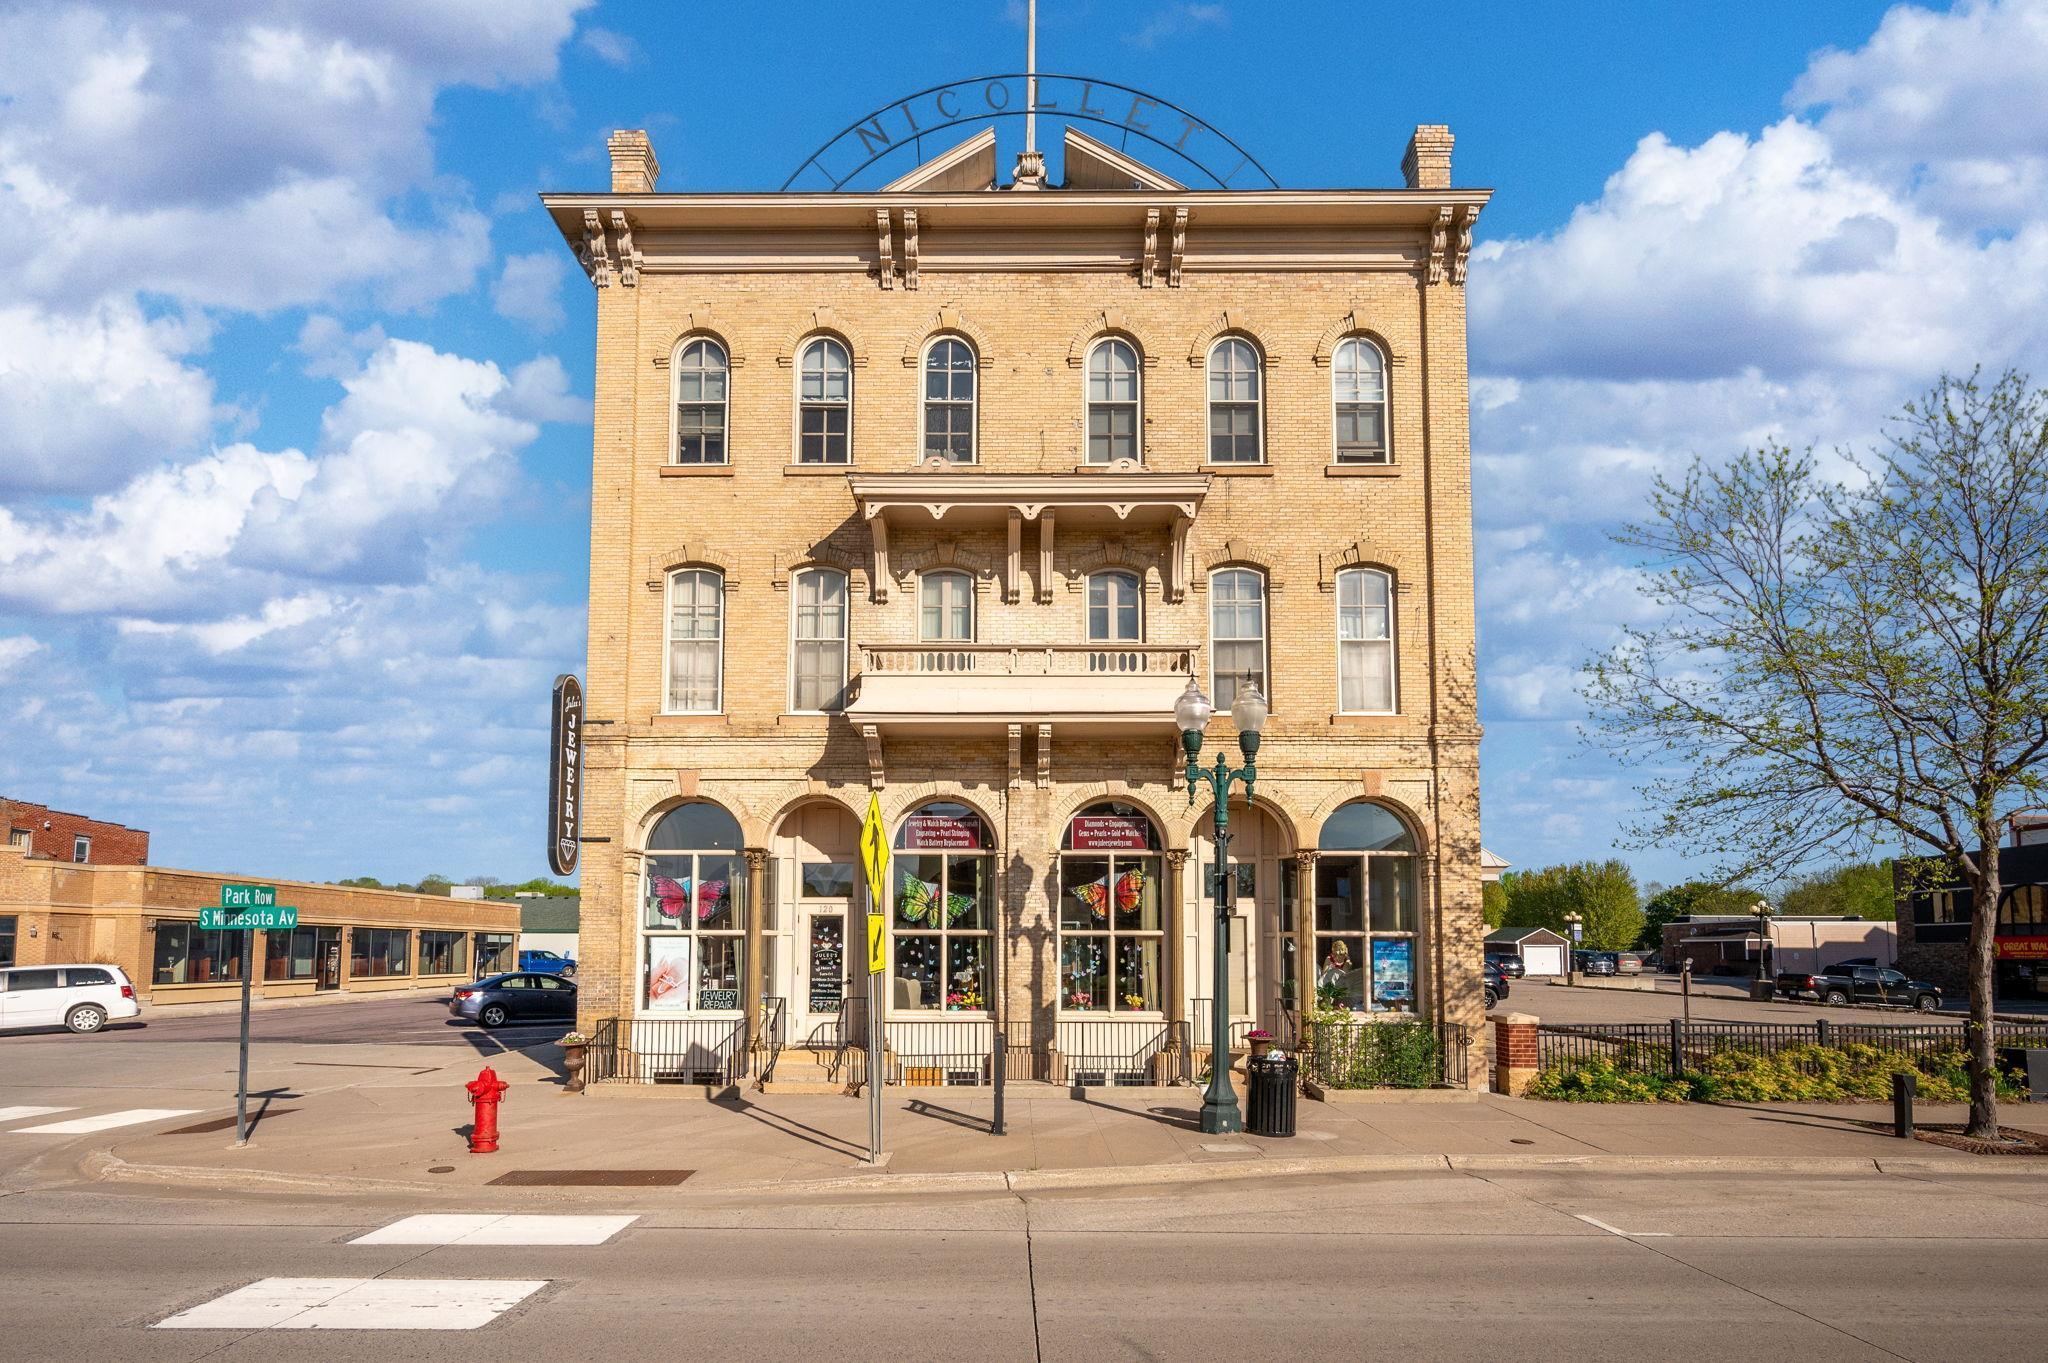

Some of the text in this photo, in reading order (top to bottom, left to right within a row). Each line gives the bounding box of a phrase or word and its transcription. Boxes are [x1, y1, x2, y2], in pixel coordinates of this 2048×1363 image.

[855, 78, 1204, 157] NICOLLET
[565, 714, 577, 837] JEWELRY
[908, 820, 922, 828] Jewelry
[940, 820, 953, 828] Repair
[1085, 820, 1105, 828] Diamonds
[929, 839, 943, 847] Battery
[944, 839, 969, 847] Replacement
[225, 888, 273, 905] Park Row
[201, 910, 295, 926] S Minnesota Av
[2003, 942, 2028, 951] GREAT
[701, 991, 737, 1001] JEWELRY
[703, 1000, 733, 1010] REPAIR
